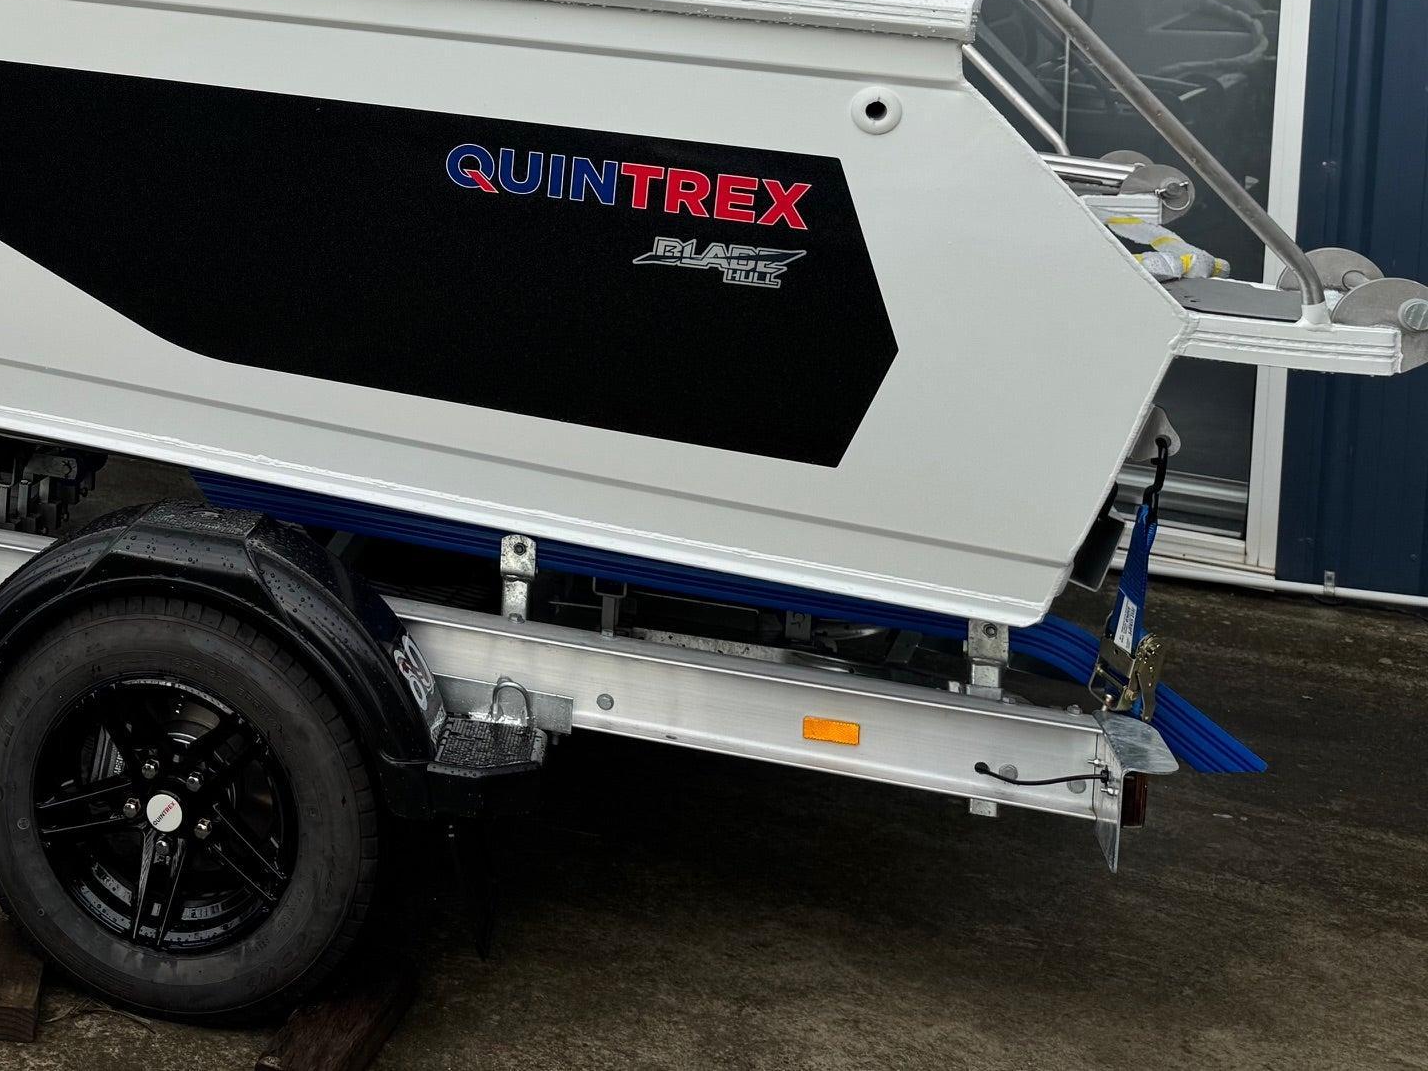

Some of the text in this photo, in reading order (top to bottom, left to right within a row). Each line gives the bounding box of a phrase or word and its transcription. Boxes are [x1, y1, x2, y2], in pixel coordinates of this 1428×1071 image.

[445, 143, 812, 230] QUINTREX
[634, 236, 807, 273] BLADE
[725, 270, 780, 287] HULL
[153, 801, 176, 826] QUINTREX
